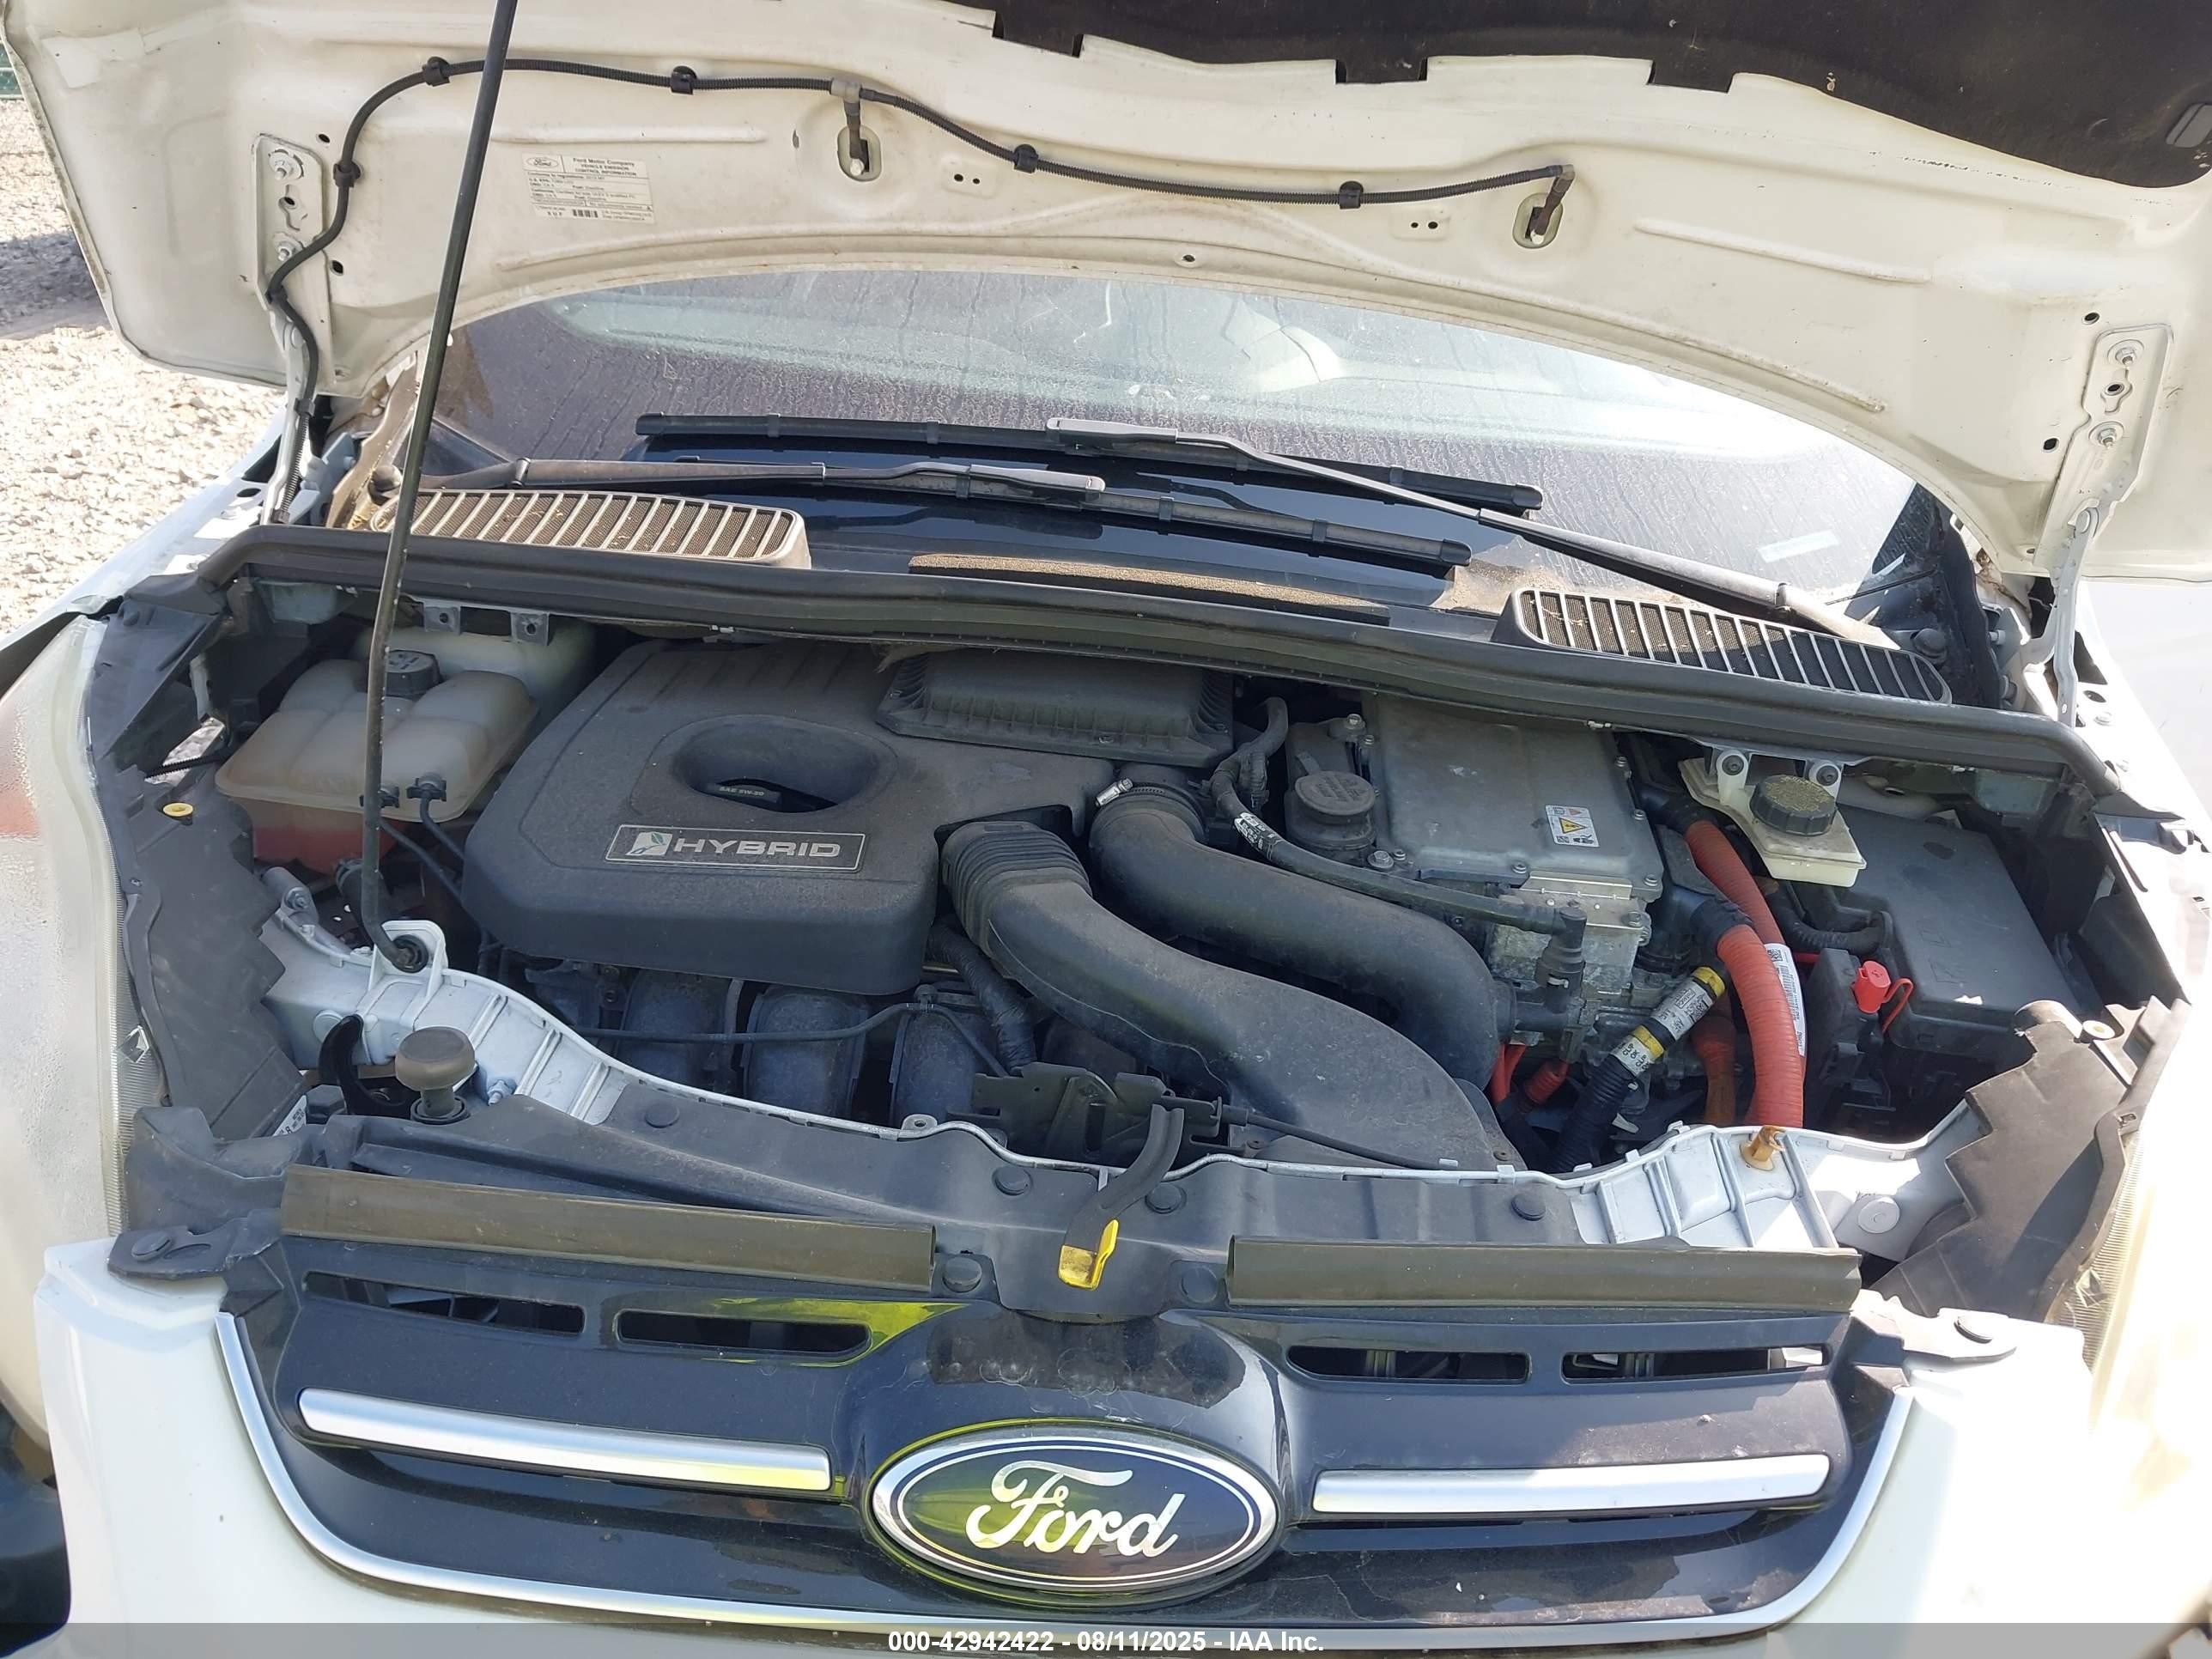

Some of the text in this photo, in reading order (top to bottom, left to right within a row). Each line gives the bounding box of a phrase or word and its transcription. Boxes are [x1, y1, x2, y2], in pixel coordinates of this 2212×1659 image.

[533, 157, 552, 167] Ford
[673, 837, 842, 858] HYBRID
[965, 1459, 1186, 1558] Ford
